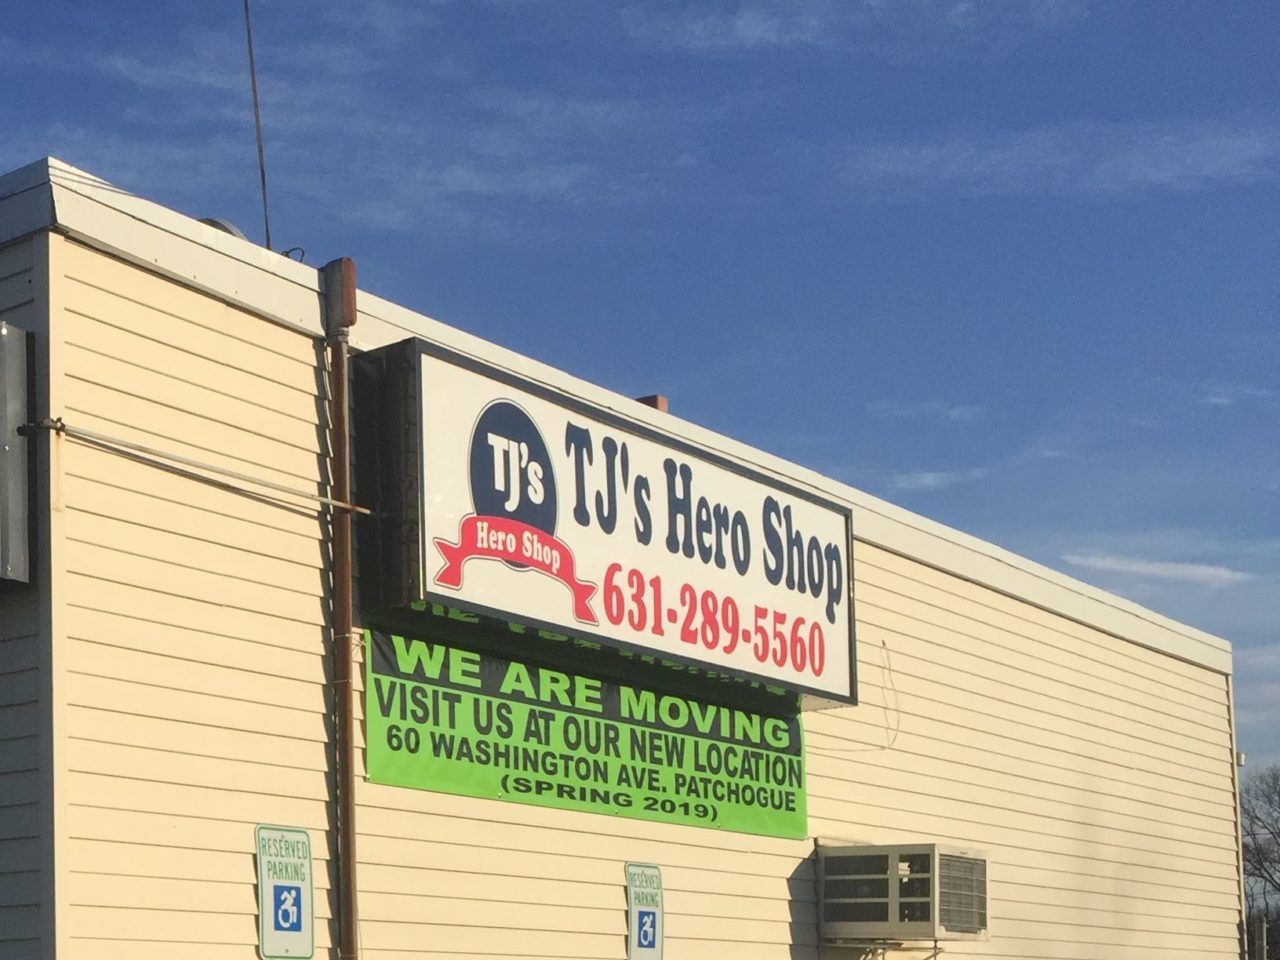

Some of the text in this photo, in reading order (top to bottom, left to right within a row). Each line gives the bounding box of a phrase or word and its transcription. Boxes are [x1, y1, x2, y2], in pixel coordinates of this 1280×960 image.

[487, 432, 545, 513] TJ's
[476, 521, 561, 574] Hero Shop
[565, 421, 842, 624] TJ's Hero Shop
[604, 563, 825, 677] 631-289-5560
[374, 678, 802, 789] VISIT US AT OUR NEW LOCATION
[391, 635, 481, 688] WE
[500, 662, 603, 713] ARE
[620, 686, 790, 749] MOVING
[386, 724, 796, 812] 60 WASHINGTON AVE. PATCHOGUE
[501, 774, 718, 821] (SPRING 2019)
[261, 838, 308, 859] RESERVED
[267, 861, 306, 881] PARKING
